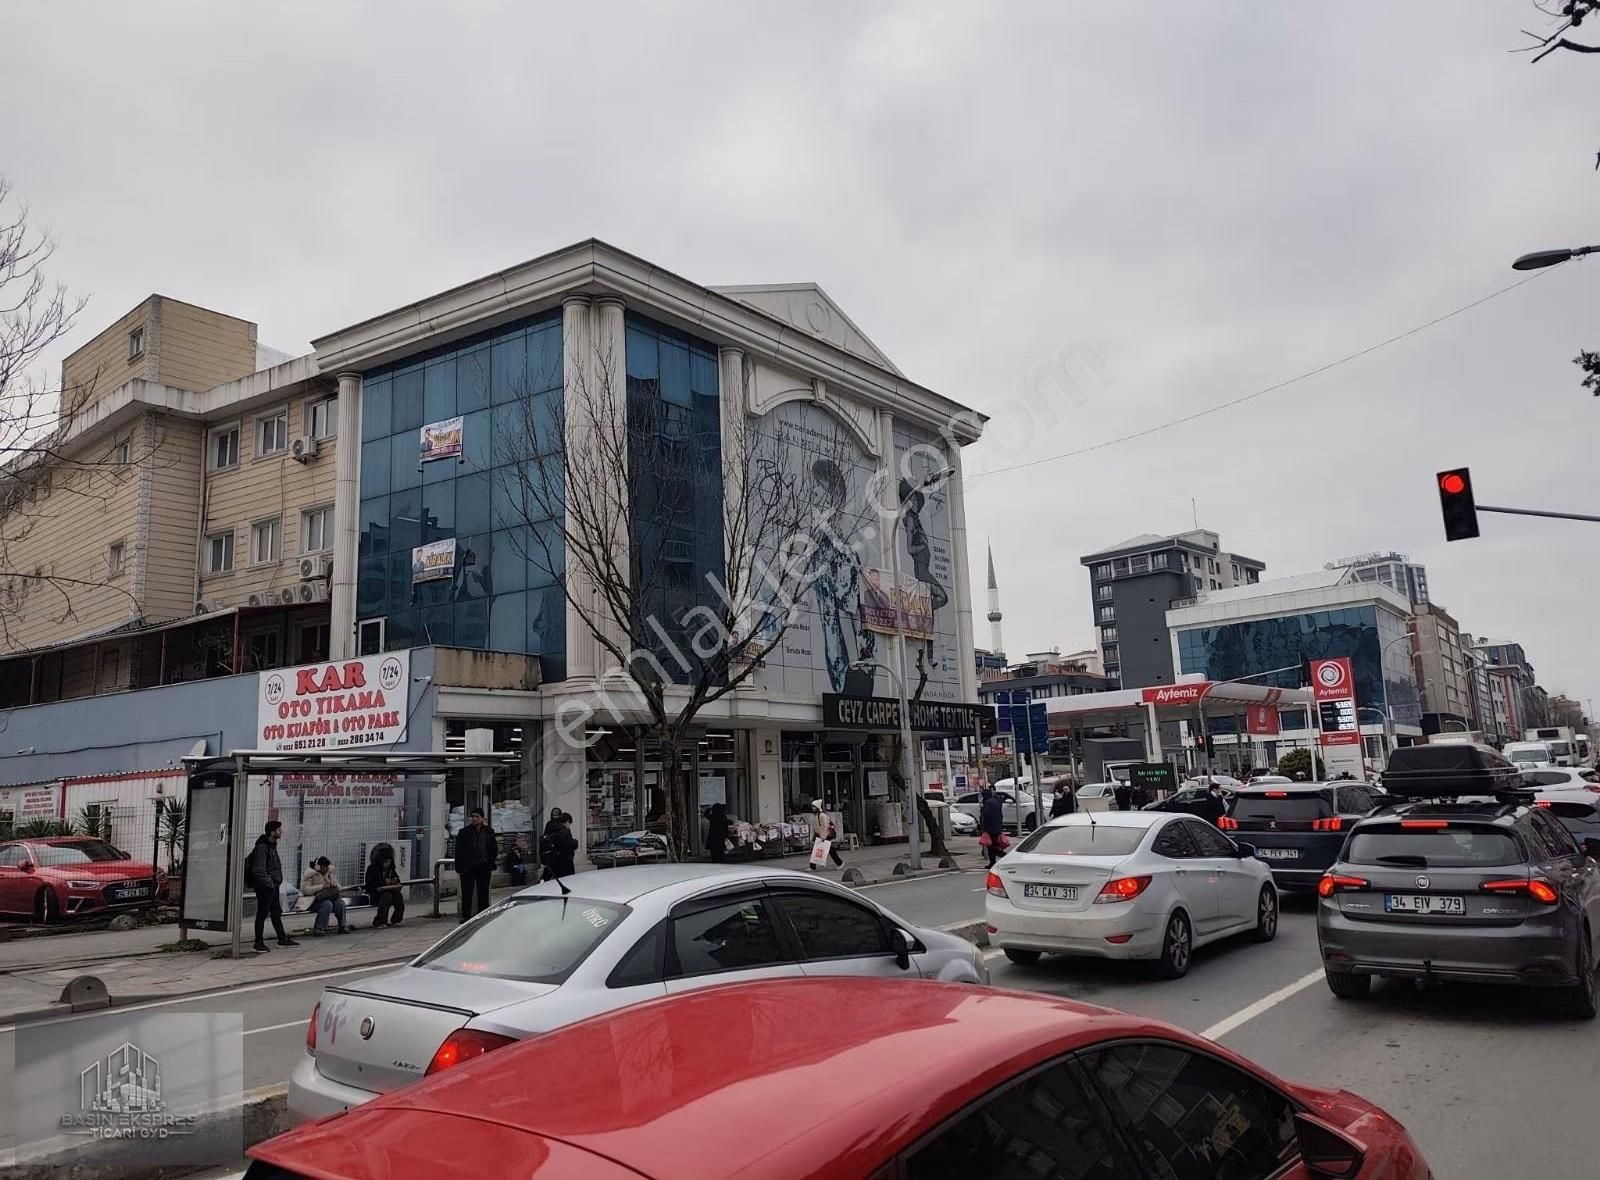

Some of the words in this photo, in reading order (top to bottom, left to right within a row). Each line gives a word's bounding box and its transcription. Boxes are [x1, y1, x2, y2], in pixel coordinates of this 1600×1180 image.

[296, 662, 366, 695] KAR
[383, 665, 398, 681] 7/24
[267, 682, 282, 696] 7/24
[1156, 687, 1198, 701] Aytemiz
[1319, 688, 1348, 696] Aytemiz
[278, 700, 312, 719] OTO
[316, 689, 386, 715] YIKAMA
[838, 700, 863, 724] CEYZ
[866, 702, 900, 726] CARPE
[914, 703, 939, 728] HOME
[941, 706, 975, 729] TEXTILE
[263, 723, 285, 740] OTO
[287, 717, 331, 738] KUAFÖR
[333, 719, 339, 733] &
[341, 715, 366, 733] OTO
[367, 711, 400, 729] PARK
[350, 734, 364, 744] 286
[1029, 885, 1039, 896] 34
[1063, 887, 1076, 899] 311
[1393, 896, 1406, 908] 34
[1440, 897, 1461, 910] 379
